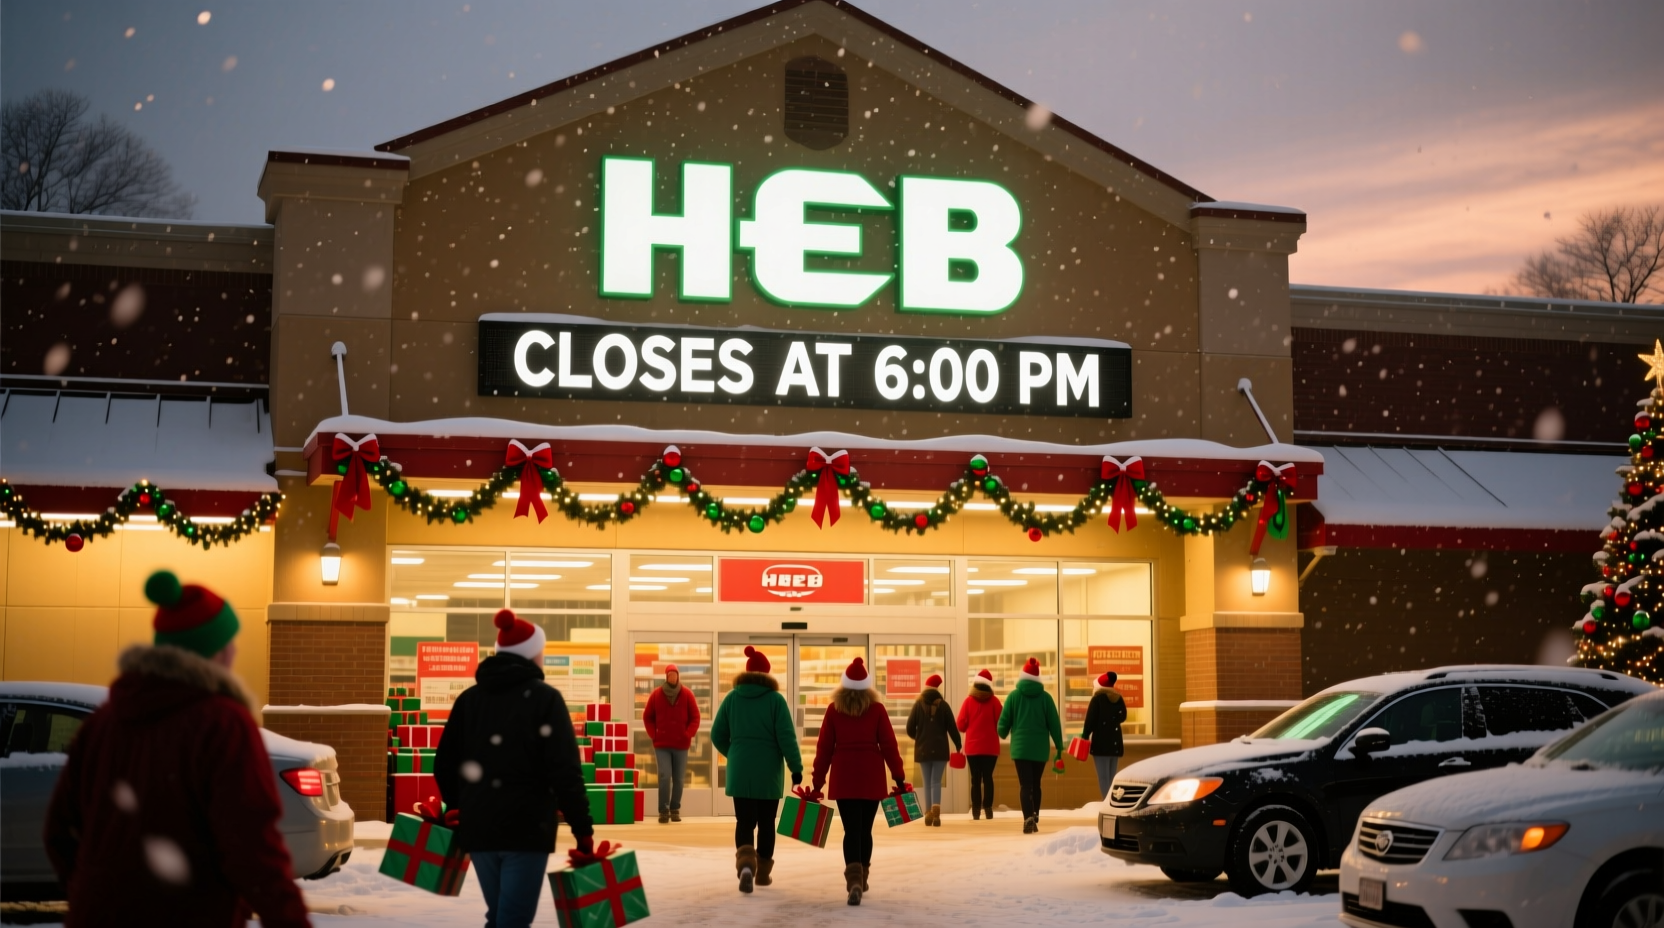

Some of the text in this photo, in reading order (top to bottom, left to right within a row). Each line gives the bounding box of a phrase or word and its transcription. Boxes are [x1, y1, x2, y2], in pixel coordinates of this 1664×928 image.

[513, 329, 1101, 408] CLOSES AT 6:00 PM
